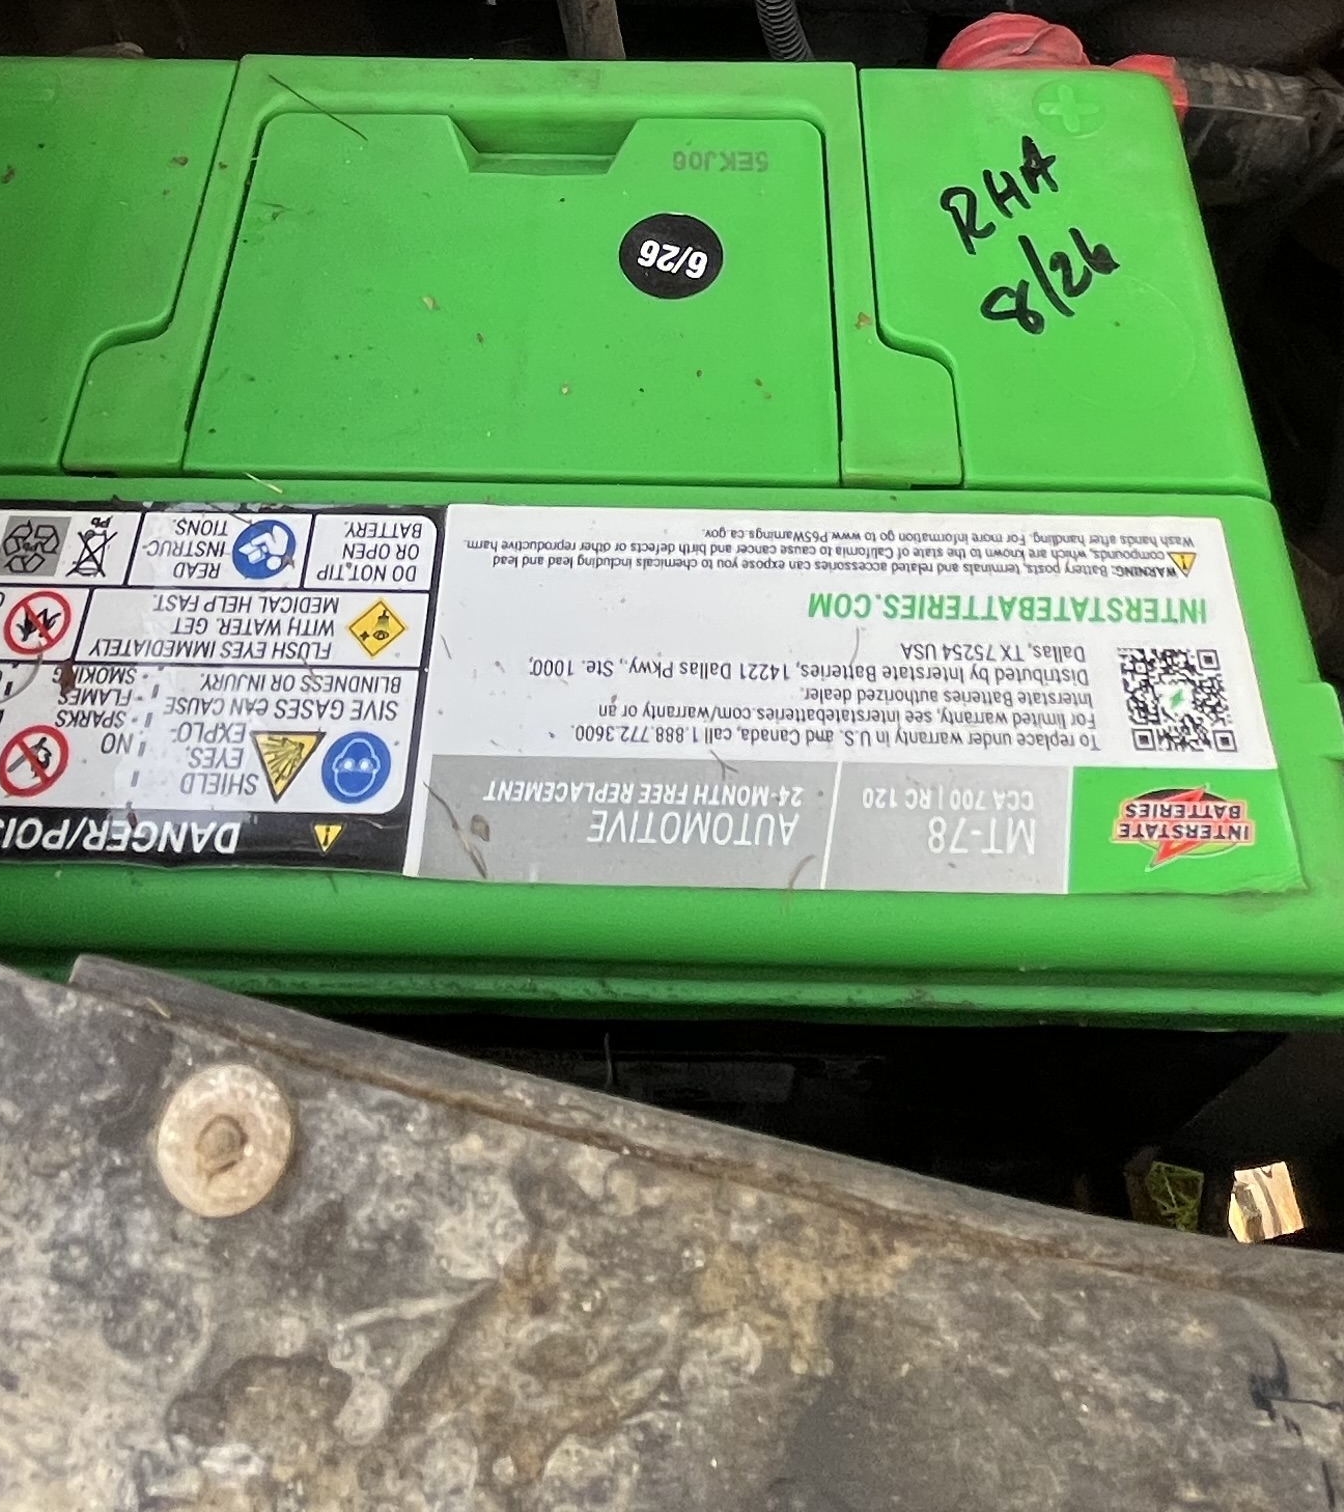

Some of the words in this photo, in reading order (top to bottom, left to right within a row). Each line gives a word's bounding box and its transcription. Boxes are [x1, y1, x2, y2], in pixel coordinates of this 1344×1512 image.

[940, 135, 1059, 254] RHA
[637, 239, 709, 279] 6/26
[981, 228, 1120, 334] 8/26
[172, 518, 228, 537] TIONS.
[343, 521, 423, 539] BATTERY.
[141, 540, 226, 558] INSTRUC-
[341, 542, 391, 560] OPEN
[396, 543, 420, 560] OR
[172, 562, 222, 580] READ
[316, 563, 344, 581] TIP
[348, 564, 387, 582] NOT
[392, 564, 417, 583] DO
[152, 594, 200, 612] FAST.
[203, 595, 252, 613] HELP
[258, 595, 340, 614] MEDICAL
[808, 592, 1207, 625] INTERSTATEBATTERIES.COM
[170, 616, 208, 635] GET
[216, 617, 282, 636] WATER.
[287, 618, 335, 637] WITH
[88, 638, 217, 659] IMMEDIATELY
[219, 640, 267, 659] EYES
[271, 641, 332, 660] FLUSH
[900, 642, 937, 660] USA
[942, 643, 993, 662] 75254
[1000, 644, 1024, 662] TX
[1028, 642, 1085, 663] Dallas,
[581, 660, 614, 678] Ste.
[679, 661, 731, 680] Dallas
[739, 663, 789, 680] 14221
[795, 661, 876, 682] Batteries,
[882, 665, 964, 684] Interstate
[970, 664, 988, 684] by
[994, 667, 1089, 686] Distributed
[199, 673, 266, 692] INJURY.
[269, 674, 295, 692] OR
[300, 674, 401, 694] BLINDNESS
[57, 687, 133, 706] FLAMES
[800, 687, 852, 704] dealer.
[857, 689, 938, 705] authorized
[944, 690, 1013, 706] Batteries
[1017, 691, 1092, 708] Interstate
[163, 696, 225, 716] CAUSE
[273, 698, 345, 720] GASES
[349, 699, 399, 721] SIVE
[599, 704, 617, 717] an
[621, 704, 638, 718] or
[642, 702, 900, 726] interstatebatteries.com/warranty
[54, 709, 127, 728] SPARKS
[905, 710, 931, 723] see
[936, 707, 1007, 727] warranty,
[1013, 712, 1065, 729] limited
[1071, 713, 1095, 729] For
[170, 722, 247, 744] EXPLO-
[570, 724, 698, 744] 1.888.772.3600.
[704, 726, 732, 744] call
[737, 726, 800, 745] Canada,
[805, 729, 834, 746] and
[839, 729, 871, 747] U.S.
[876, 730, 889, 748] in
[895, 727, 963, 747] warranty
[968, 732, 1012, 749] under
[1017, 730, 1075, 750] replace
[1080, 733, 1101, 751] To
[100, 732, 134, 755] NO
[185, 746, 244, 769] EYES.
[179, 772, 259, 796] SHIELD
[483, 780, 634, 804] REPLACEMENT
[638, 783, 688, 805] FREE
[693, 784, 804, 807] 24-MONTH
[862, 787, 898, 808] 120
[904, 788, 932, 809] RC
[950, 789, 984, 810] 700
[992, 790, 1034, 811] CCA
[1125, 803, 1241, 819] BATTERIES
[587, 809, 799, 845] AUTOMOTIVE
[928, 816, 1036, 856] MT-78
[1119, 823, 1249, 840] INTERSTATE
